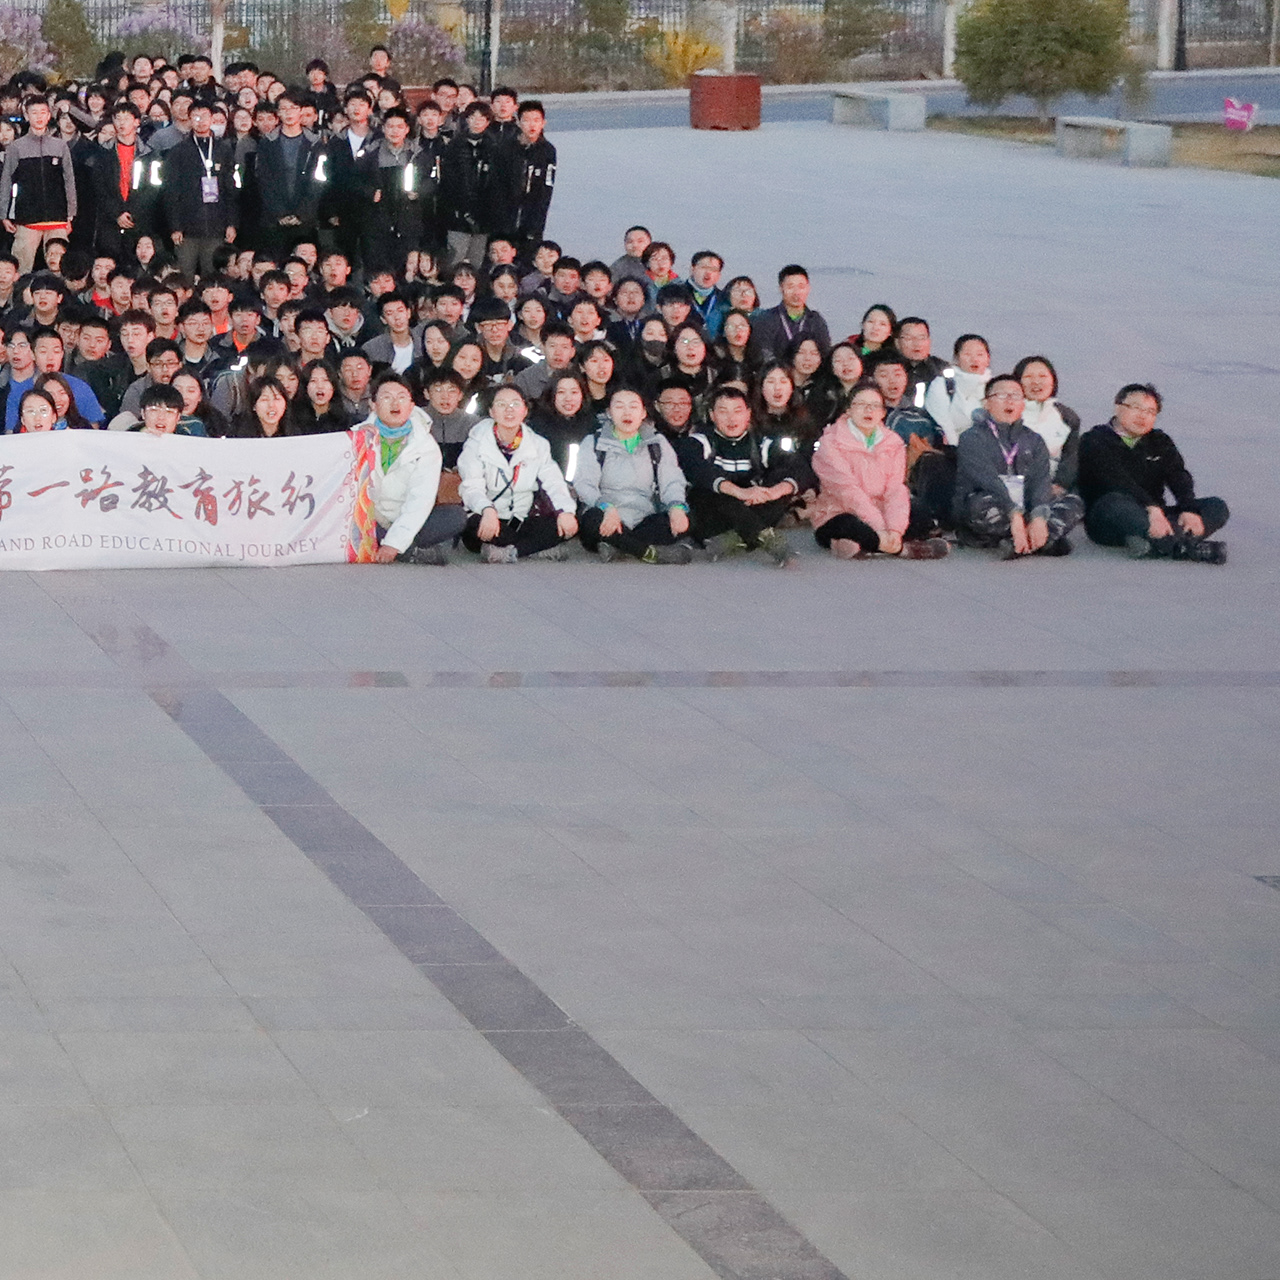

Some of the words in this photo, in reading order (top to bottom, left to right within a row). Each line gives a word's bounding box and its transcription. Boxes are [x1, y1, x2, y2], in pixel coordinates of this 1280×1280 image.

[42, 534, 93, 550] ROAD
[100, 534, 236, 557] EDUCATIONAL
[239, 536, 320, 561] JOURNEY
